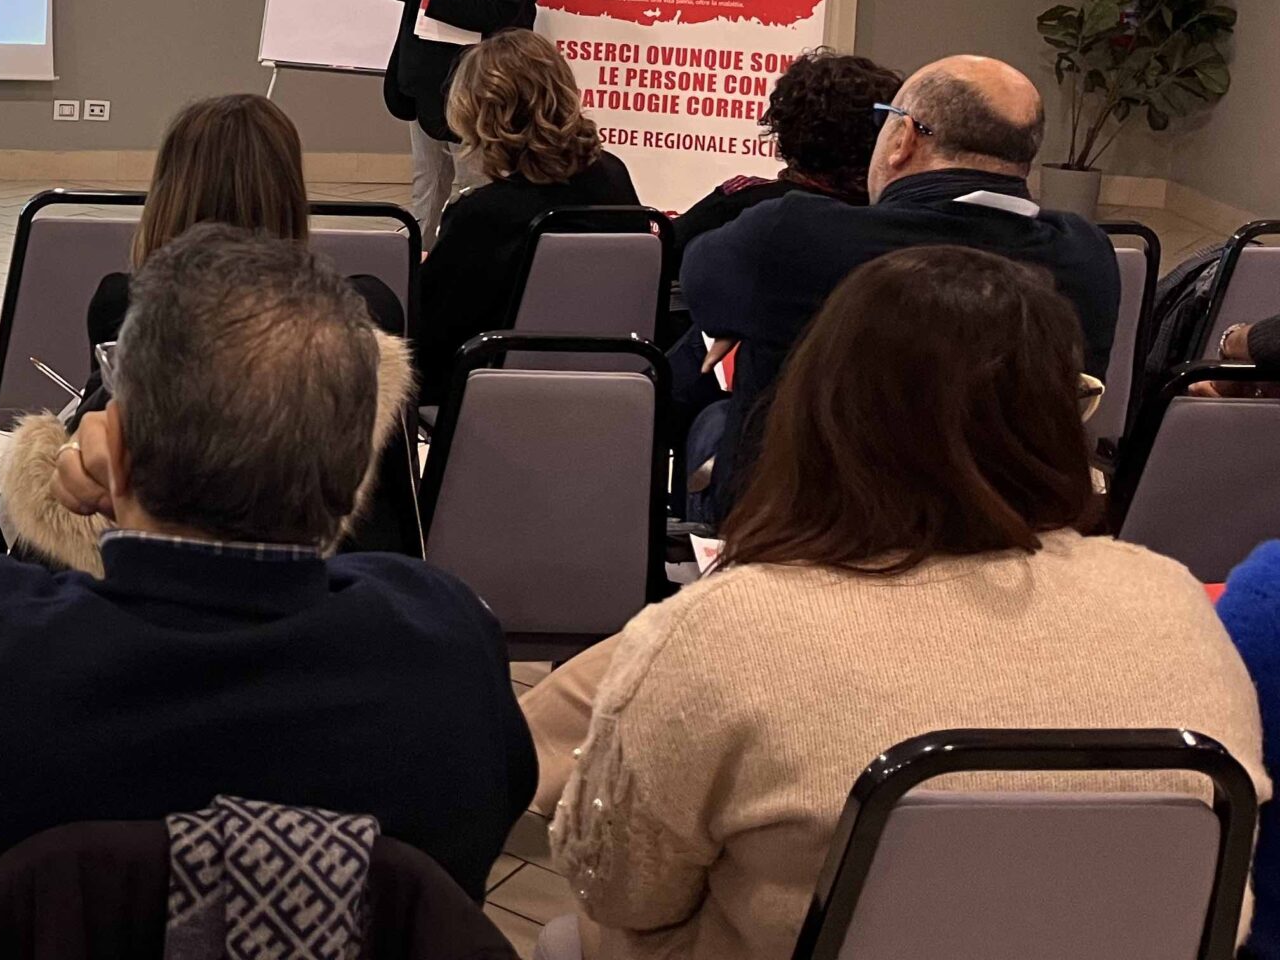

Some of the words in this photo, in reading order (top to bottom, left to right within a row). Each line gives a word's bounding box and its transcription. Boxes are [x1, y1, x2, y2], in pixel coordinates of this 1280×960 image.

[556, 40, 640, 64] ESSERCI
[646, 45, 743, 71] OVUNQUE
[750, 52, 793, 74] SON
[599, 66, 619, 86] LE
[625, 68, 717, 94] PERSONE
[724, 74, 767, 97] CON
[578, 88, 680, 115] ATOLOGIE
[686, 96, 765, 121] CORREL
[599, 128, 638, 147] SEDE
[643, 131, 737, 154] REGIONALE
